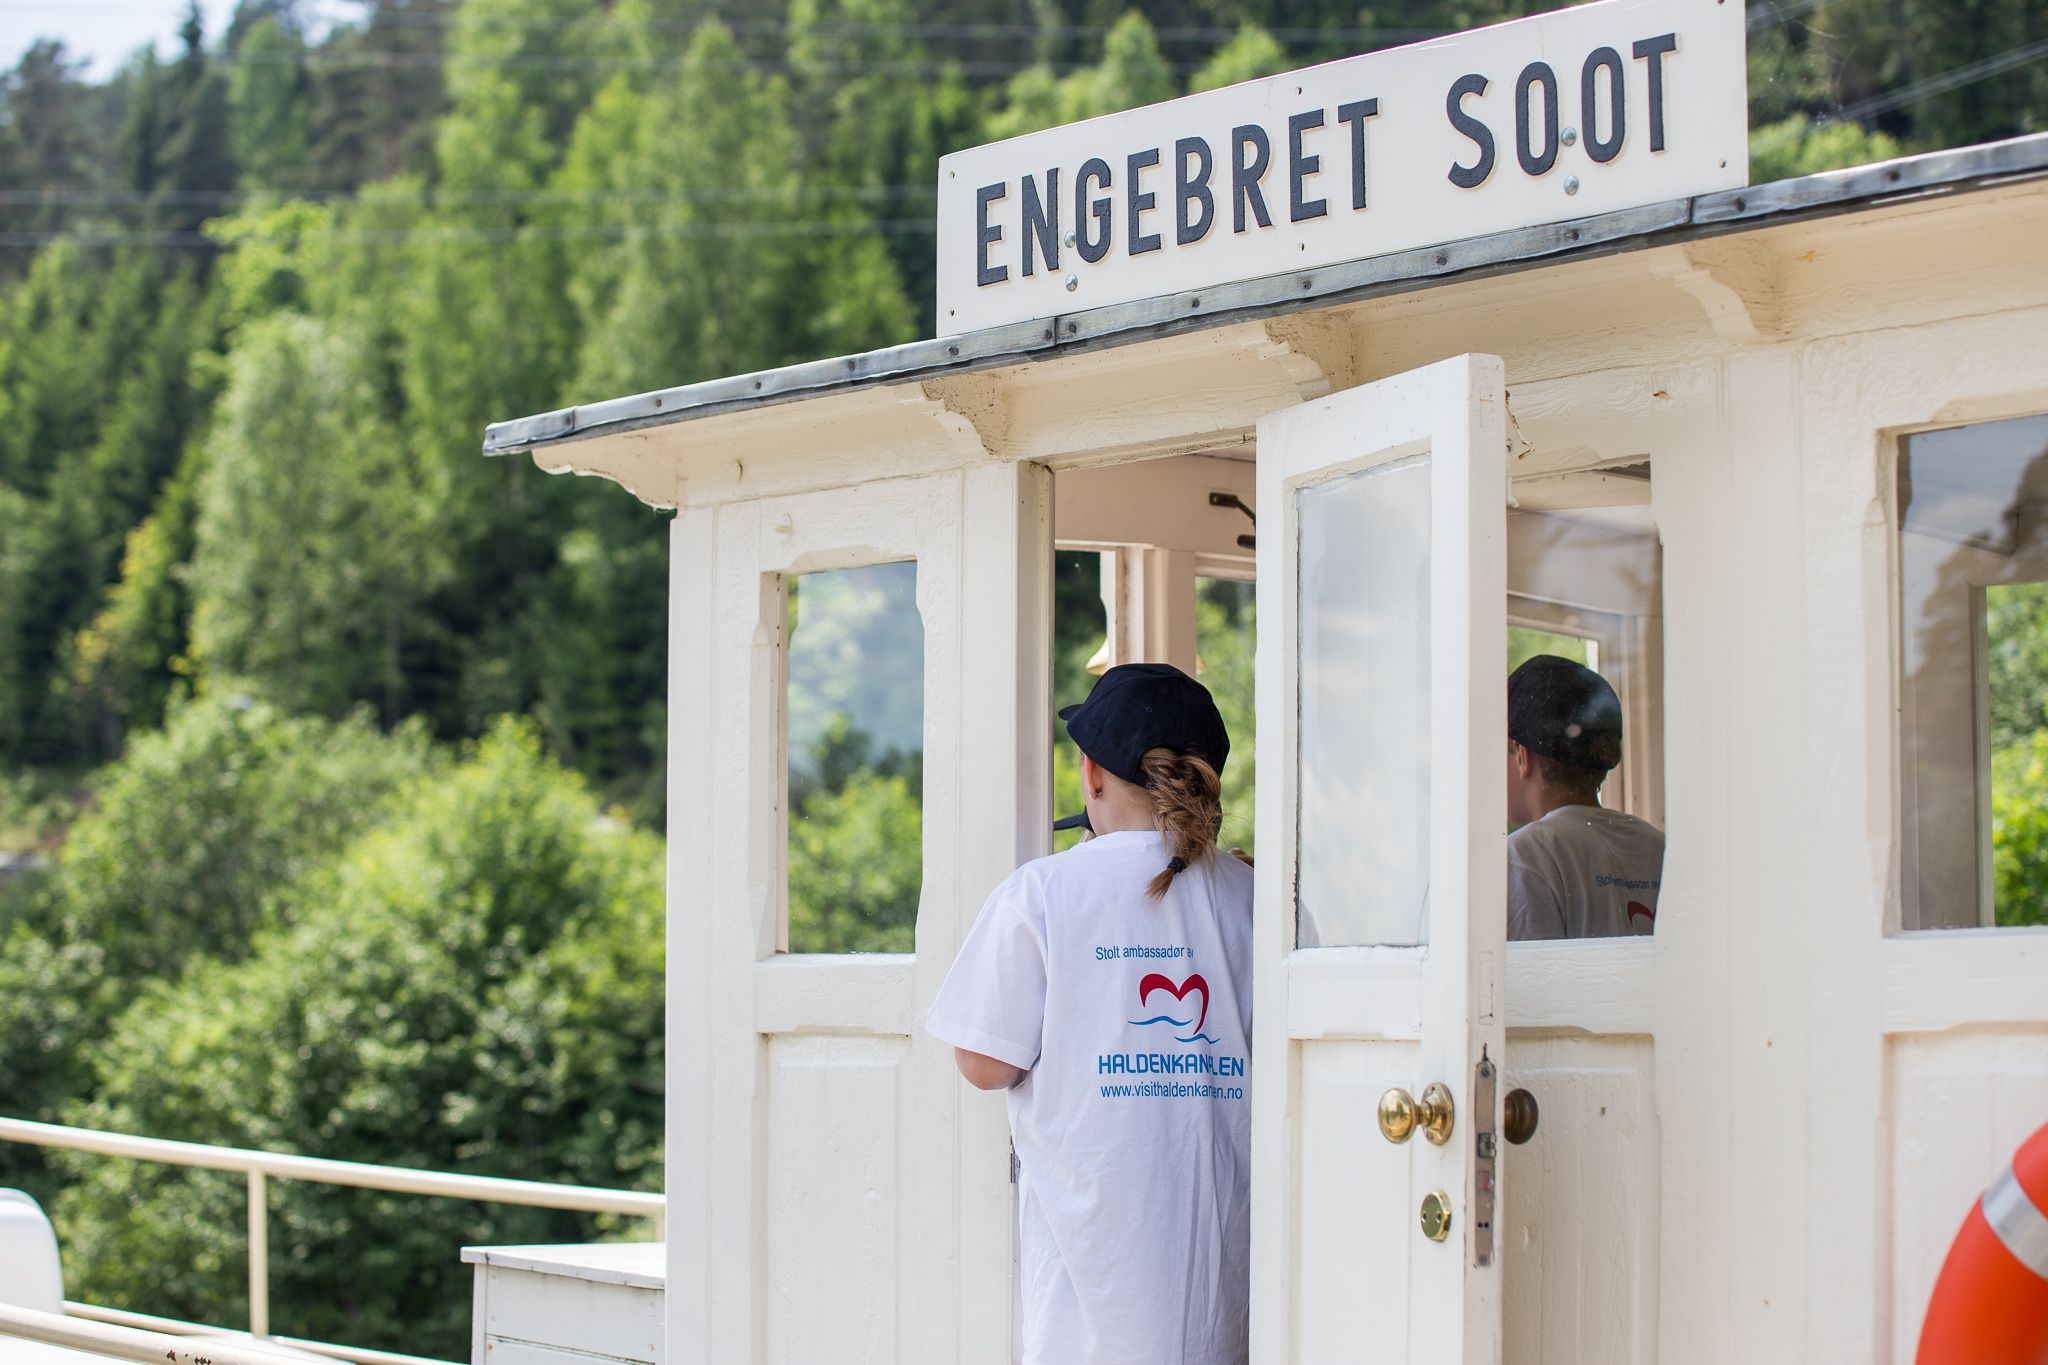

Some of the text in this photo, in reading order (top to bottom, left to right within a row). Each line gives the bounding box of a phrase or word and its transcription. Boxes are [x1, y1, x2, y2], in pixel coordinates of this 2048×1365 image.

[976, 31, 1678, 288] ENGEBRET SOOT
[1095, 945, 1120, 961] Stolt
[1123, 944, 1185, 959] ambassadør
